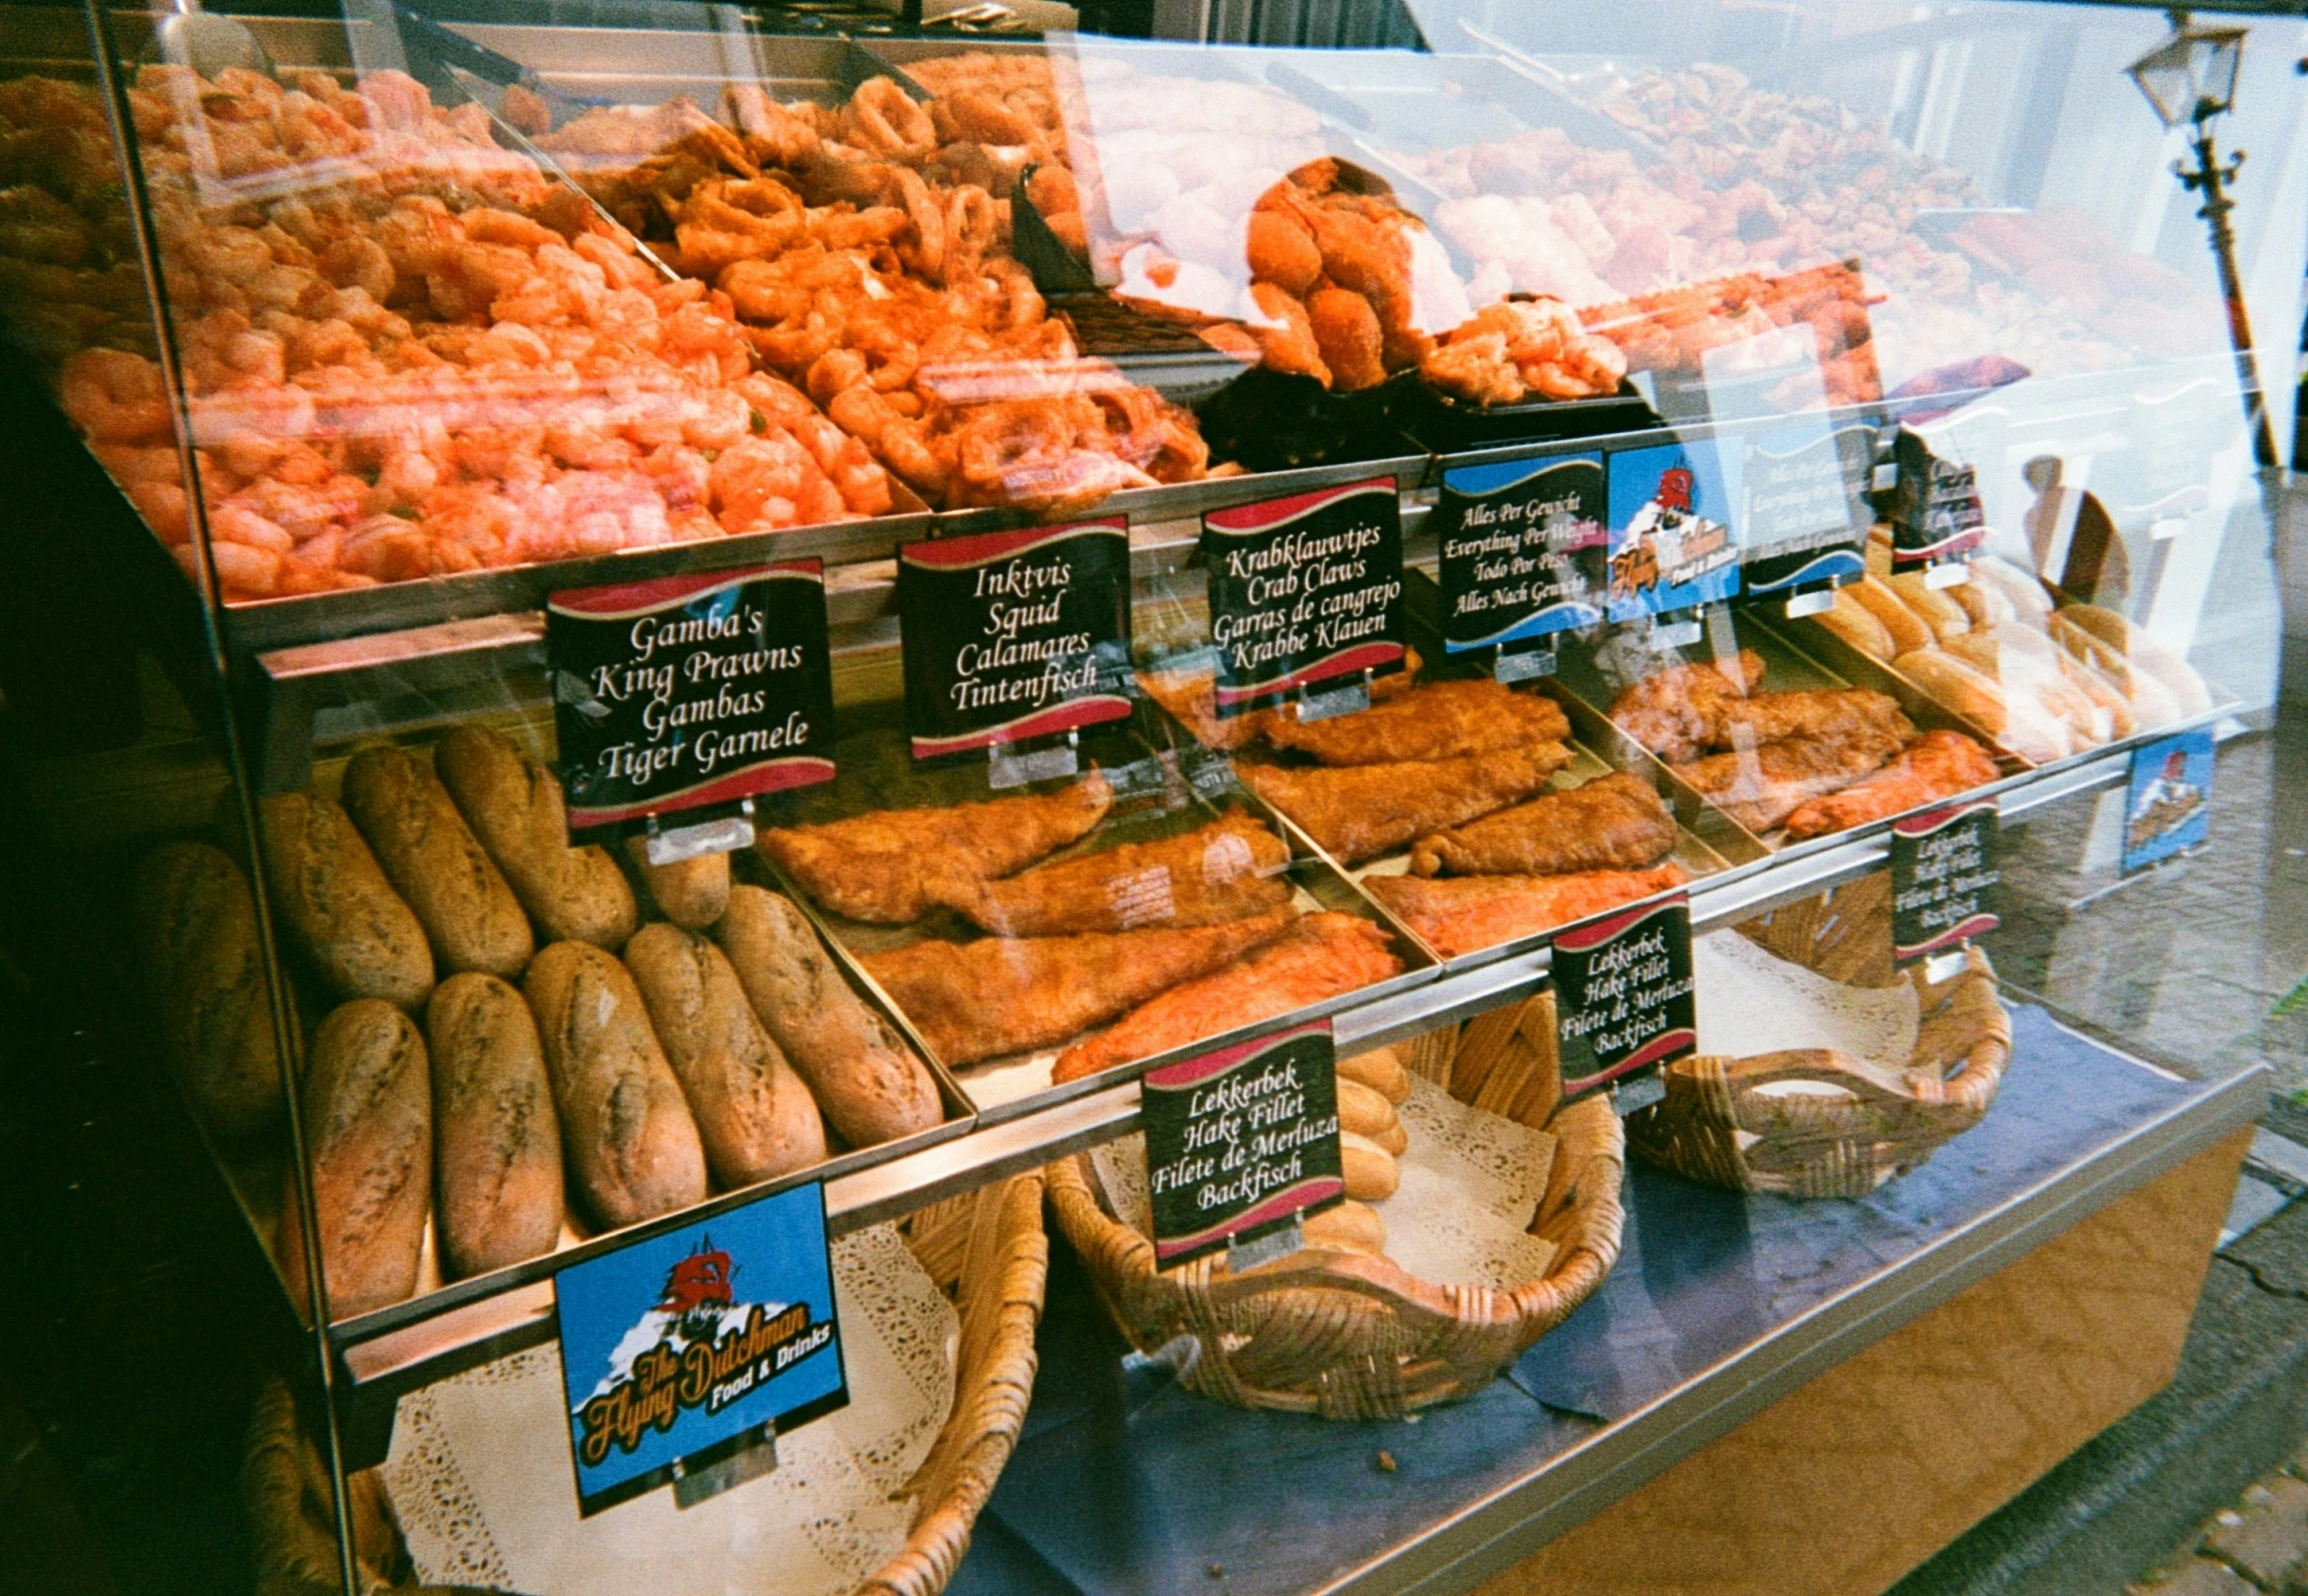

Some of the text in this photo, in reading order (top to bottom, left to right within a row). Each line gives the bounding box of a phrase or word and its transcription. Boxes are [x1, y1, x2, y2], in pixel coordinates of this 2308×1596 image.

[1445, 515, 1598, 560] Everything Per Weight
[1460, 491, 1581, 530] Alles Per Gewicht
[974, 556, 1072, 598] Inktvis
[1227, 522, 1381, 578] Krabklauwtjes
[1474, 553, 1568, 581] Todo Por Peso
[1248, 557, 1366, 605] Crab Claws
[1453, 572, 1587, 617] Alles Nach Gewicht
[631, 603, 764, 661] Gamba's
[984, 589, 1067, 638] Squid
[1214, 575, 1401, 649] Garras de cangrejo
[957, 632, 1091, 676] Calamares
[1232, 614, 1386, 669] Krabbe Klauen
[591, 644, 803, 701] King Prawns
[951, 655, 1097, 710] Tintenfisch
[643, 683, 766, 742] Gambas
[598, 711, 809, 785] Tiger Garnele
[1588, 927, 1669, 976] Lekkerbek
[1584, 956, 1670, 1005] Hake Fillet
[1560, 1009, 1608, 1041] Filete
[1611, 1000, 1630, 1022] de
[1594, 1006, 1668, 1054] Backfisch
[1188, 1058, 1304, 1118] Lekkerbek
[1183, 1092, 1306, 1153] Hake Fillet
[1152, 1116, 1339, 1194] Filete de Merluza
[1197, 1151, 1303, 1210] Backfisch
[586, 1304, 807, 1461] Flying Dutchman
[637, 1346, 678, 1393] The
[711, 1325, 831, 1411] Food & Drinks
